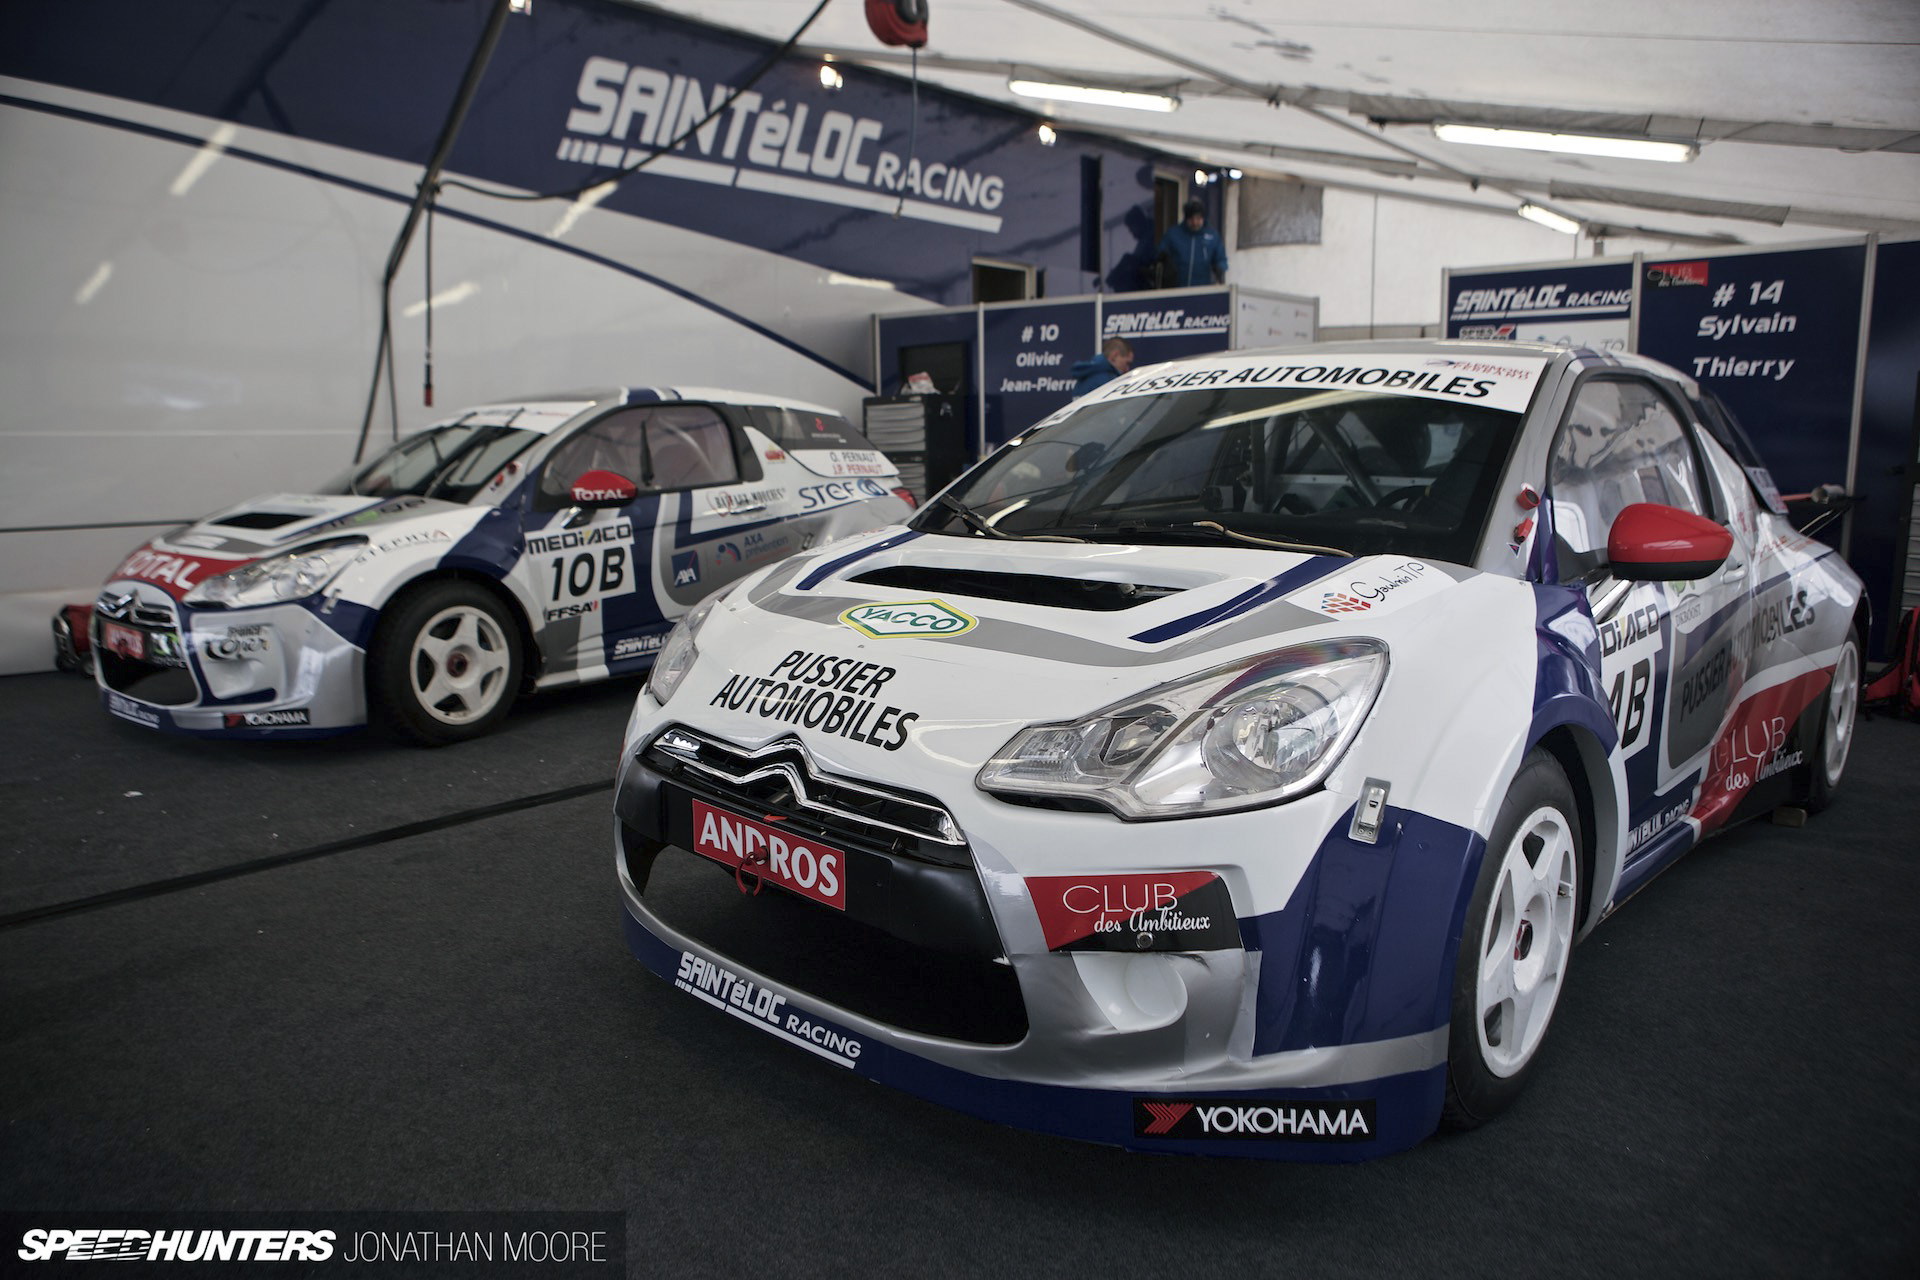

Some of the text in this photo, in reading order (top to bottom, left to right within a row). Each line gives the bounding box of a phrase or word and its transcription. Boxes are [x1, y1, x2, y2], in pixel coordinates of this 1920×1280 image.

[874, 152, 1004, 211] RACING
[1566, 288, 1632, 308] RACING
[1712, 280, 1785, 307] # 14
[1021, 324, 1060, 342] # 10
[1184, 314, 1230, 329] RACING
[1697, 311, 1796, 340] Sylvain
[1016, 351, 1064, 368] Olivier
[1693, 356, 1796, 381] Thierry
[1000, 376, 1077, 392] Jean-Pierr
[1112, 368, 1222, 399] PUSSIER
[1225, 365, 1497, 399] AUTOMOBILES
[574, 486, 627, 501] TOTAL
[117, 551, 201, 590] TOTAL
[551, 546, 625, 601] 10B
[673, 567, 697, 587] AXA
[861, 607, 958, 631] YACCO
[770, 650, 897, 699] PUSSIER
[1680, 650, 1726, 723] PUSSIER
[710, 674, 920, 752] AUTOMOBILES
[1714, 716, 1786, 772] CLUB
[1726, 763, 1750, 791] des
[699, 811, 839, 897] ANDROS
[1062, 882, 1179, 914] CLUB
[1094, 907, 1211, 934] des Ambitieux
[785, 1013, 862, 1059] RACING
[1196, 1105, 1369, 1136] YOKOHAMA
